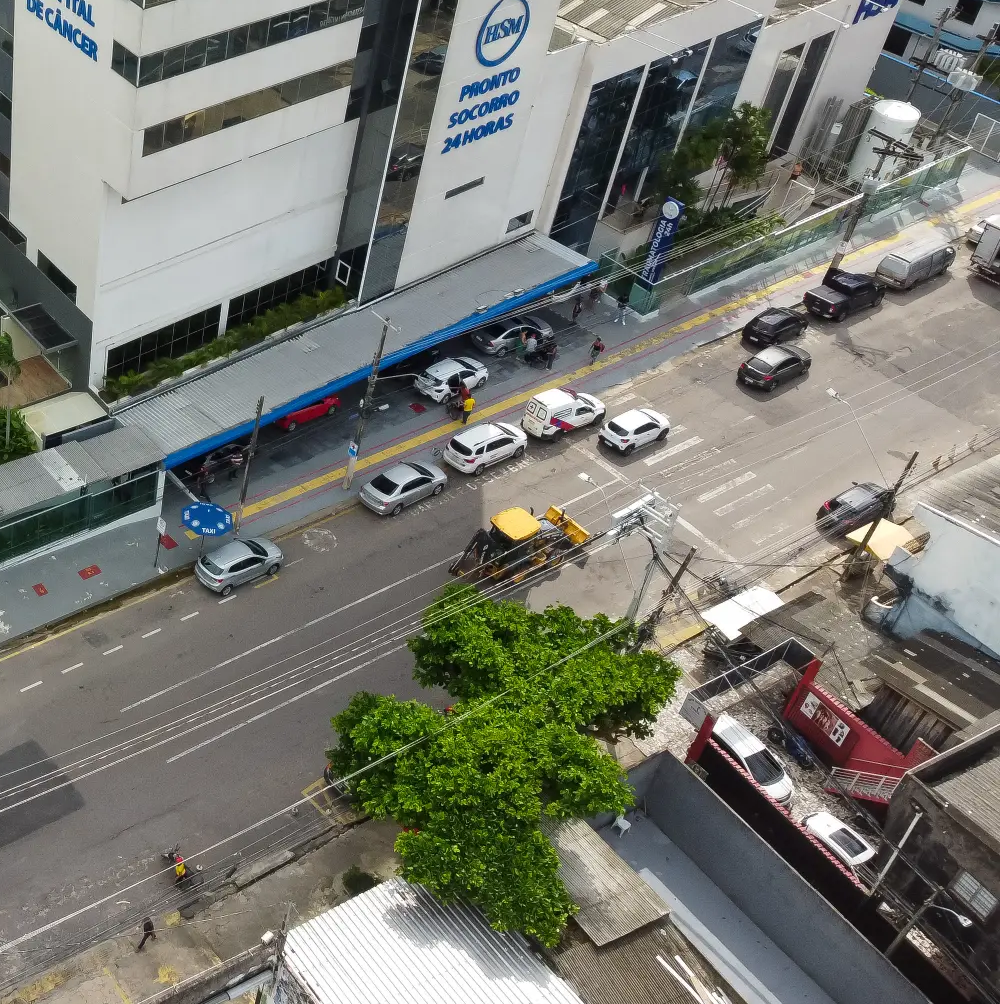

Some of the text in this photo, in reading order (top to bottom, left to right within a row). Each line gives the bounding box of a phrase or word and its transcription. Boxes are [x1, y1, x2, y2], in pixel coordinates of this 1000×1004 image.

[45, 8, 98, 62] CÂNCER
[482, 14, 525, 45] HSM
[459, 67, 520, 102] PRONTO
[448, 90, 520, 129] SOCORRO
[441, 113, 514, 154] 24 HORAS
